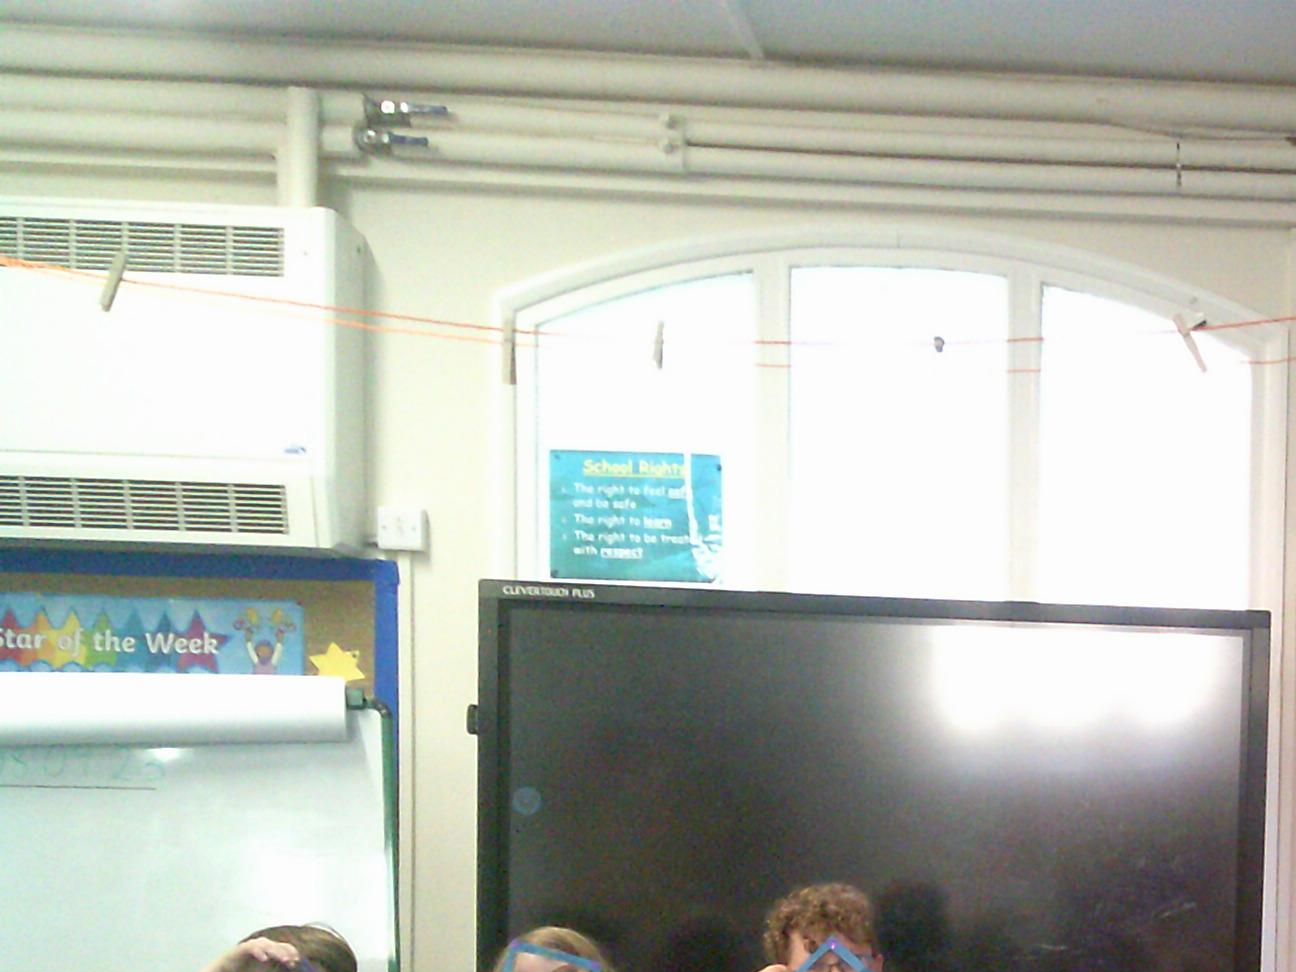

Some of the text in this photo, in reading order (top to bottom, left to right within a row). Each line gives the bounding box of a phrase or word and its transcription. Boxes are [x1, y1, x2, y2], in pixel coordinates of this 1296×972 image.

[583, 459, 633, 475] School
[574, 482, 593, 494] The
[598, 485, 624, 497] right
[629, 486, 640, 495] to
[612, 499, 636, 509] safe
[574, 513, 594, 525] The
[598, 515, 624, 528] right
[629, 516, 640, 526] to
[574, 530, 595, 542] The
[598, 532, 624, 545] right
[629, 533, 640, 543] to
[57, 628, 84, 657] of
[93, 629, 136, 653] the
[145, 632, 220, 654] Week
